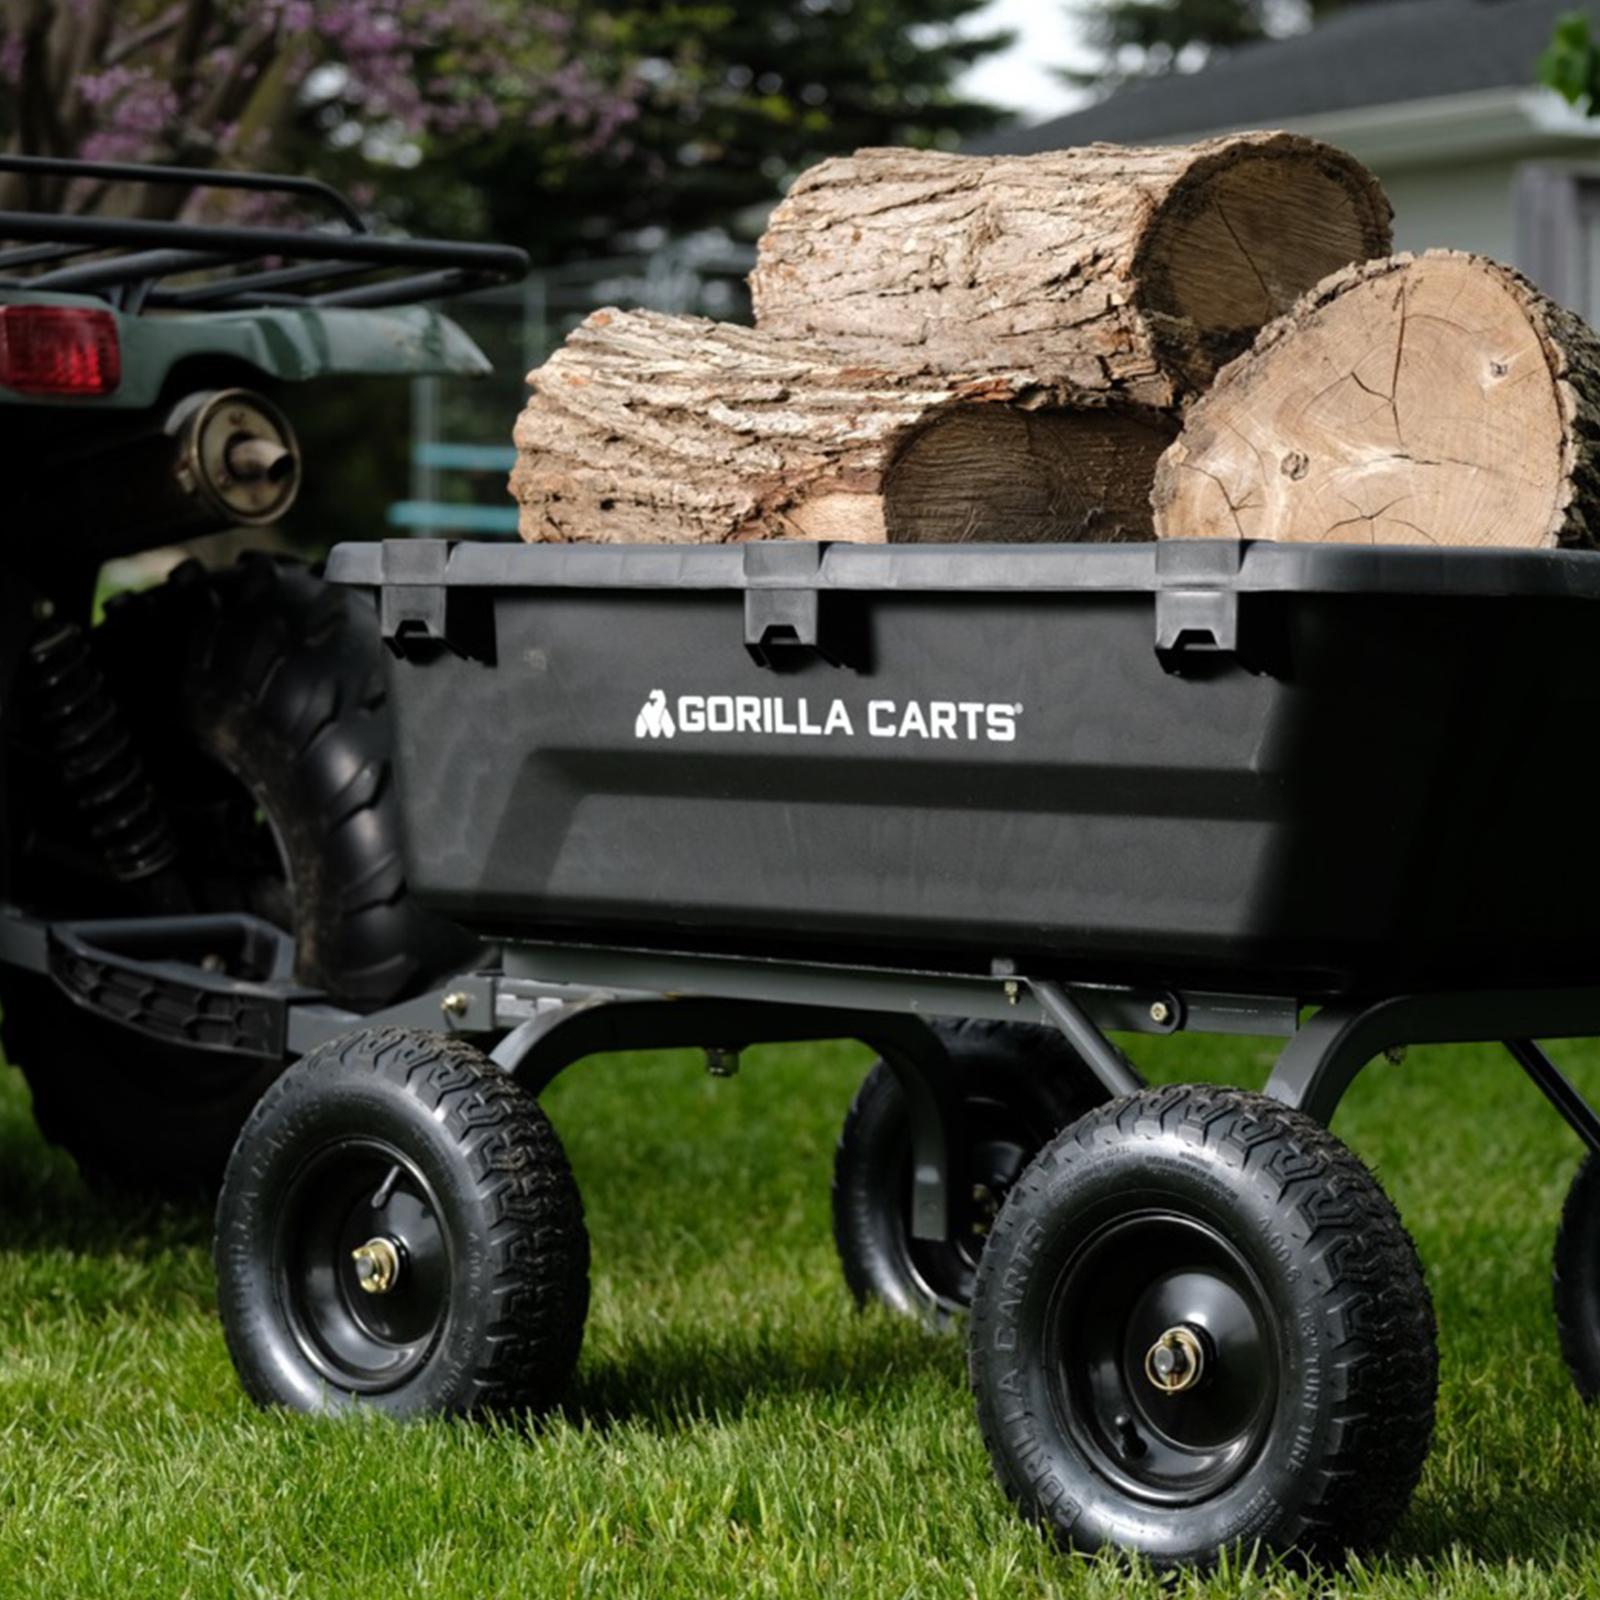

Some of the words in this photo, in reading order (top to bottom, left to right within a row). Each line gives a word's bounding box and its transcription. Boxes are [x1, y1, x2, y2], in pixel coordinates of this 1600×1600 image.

[678, 696, 854, 736] GORILLA
[868, 700, 1016, 741] CARTS
[994, 1218, 1046, 1349] CARTS
[997, 1367, 1083, 1528] GORILLA
